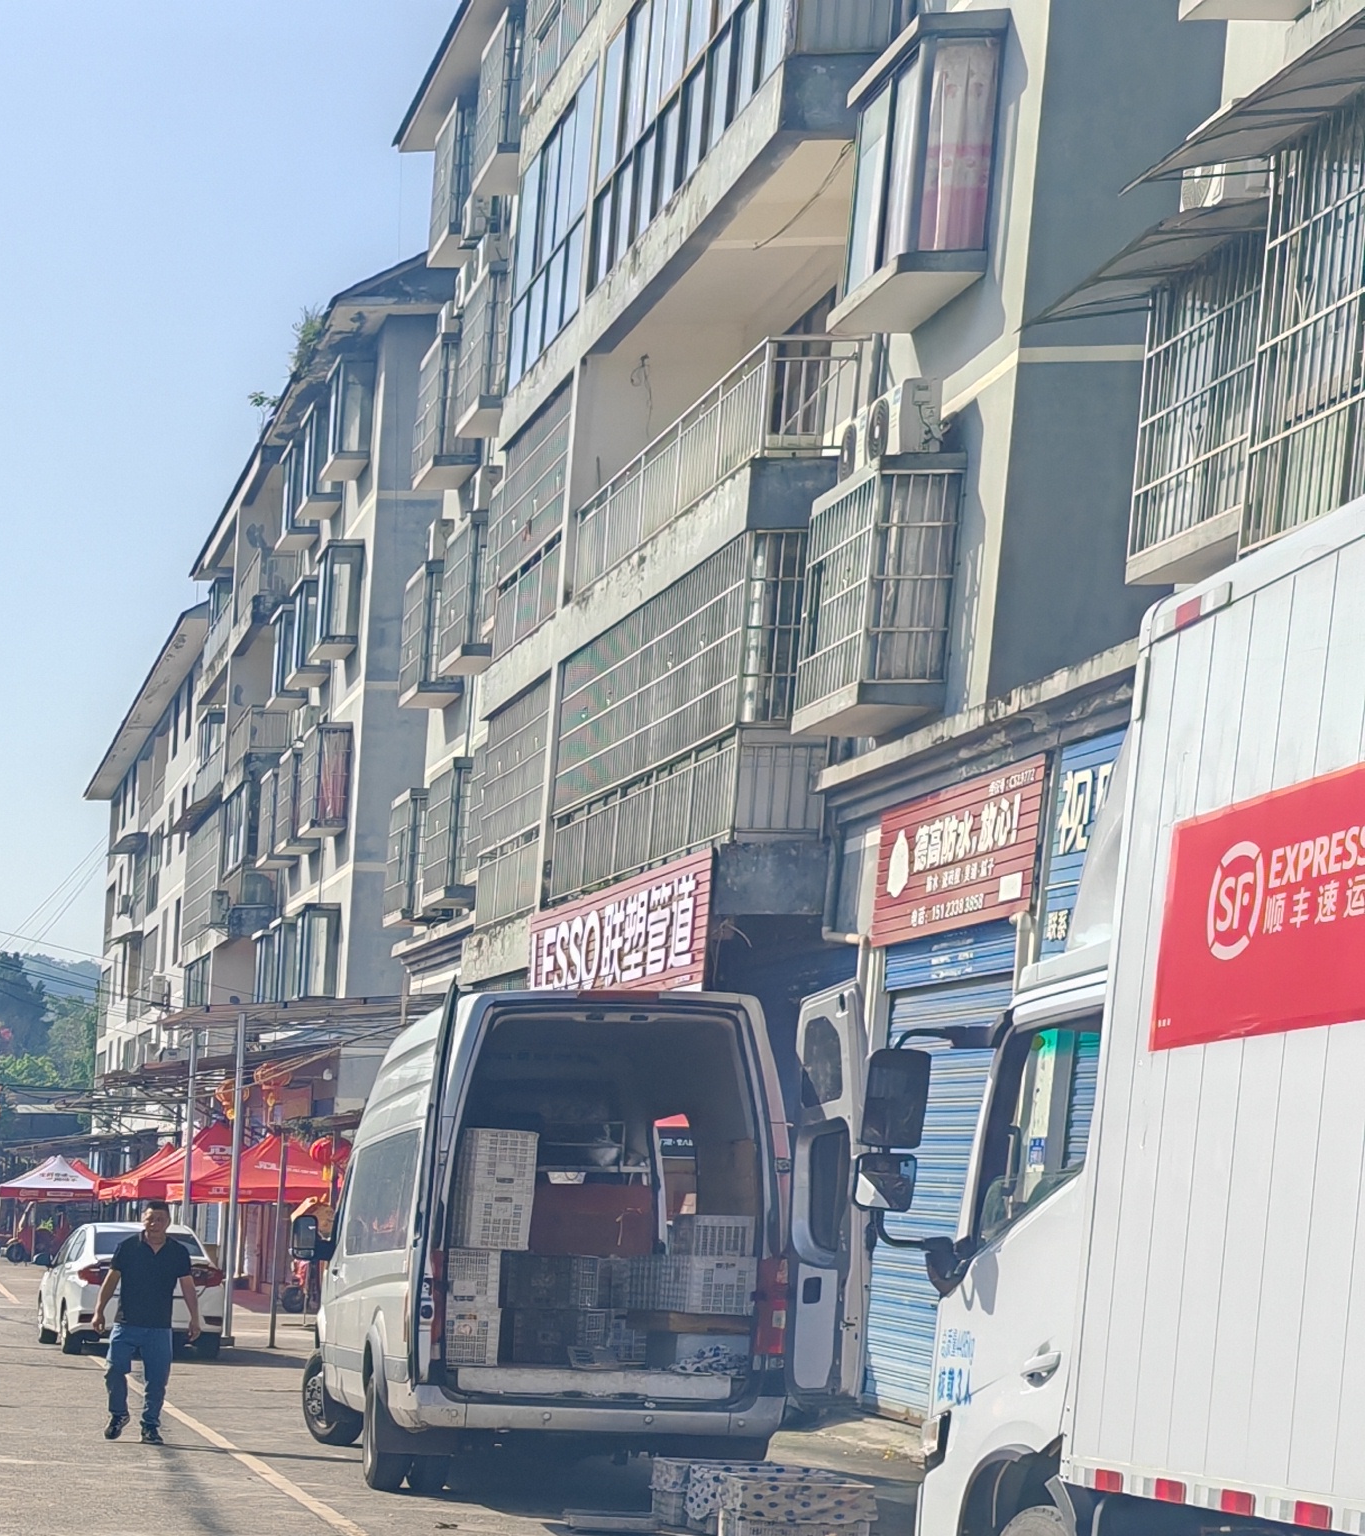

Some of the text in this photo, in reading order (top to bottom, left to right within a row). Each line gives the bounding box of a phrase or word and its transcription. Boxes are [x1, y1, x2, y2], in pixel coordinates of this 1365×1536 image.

[530, 872, 698, 990] LESSO 联塑管道
[1262, 873, 1365, 936] 顺丰速运
